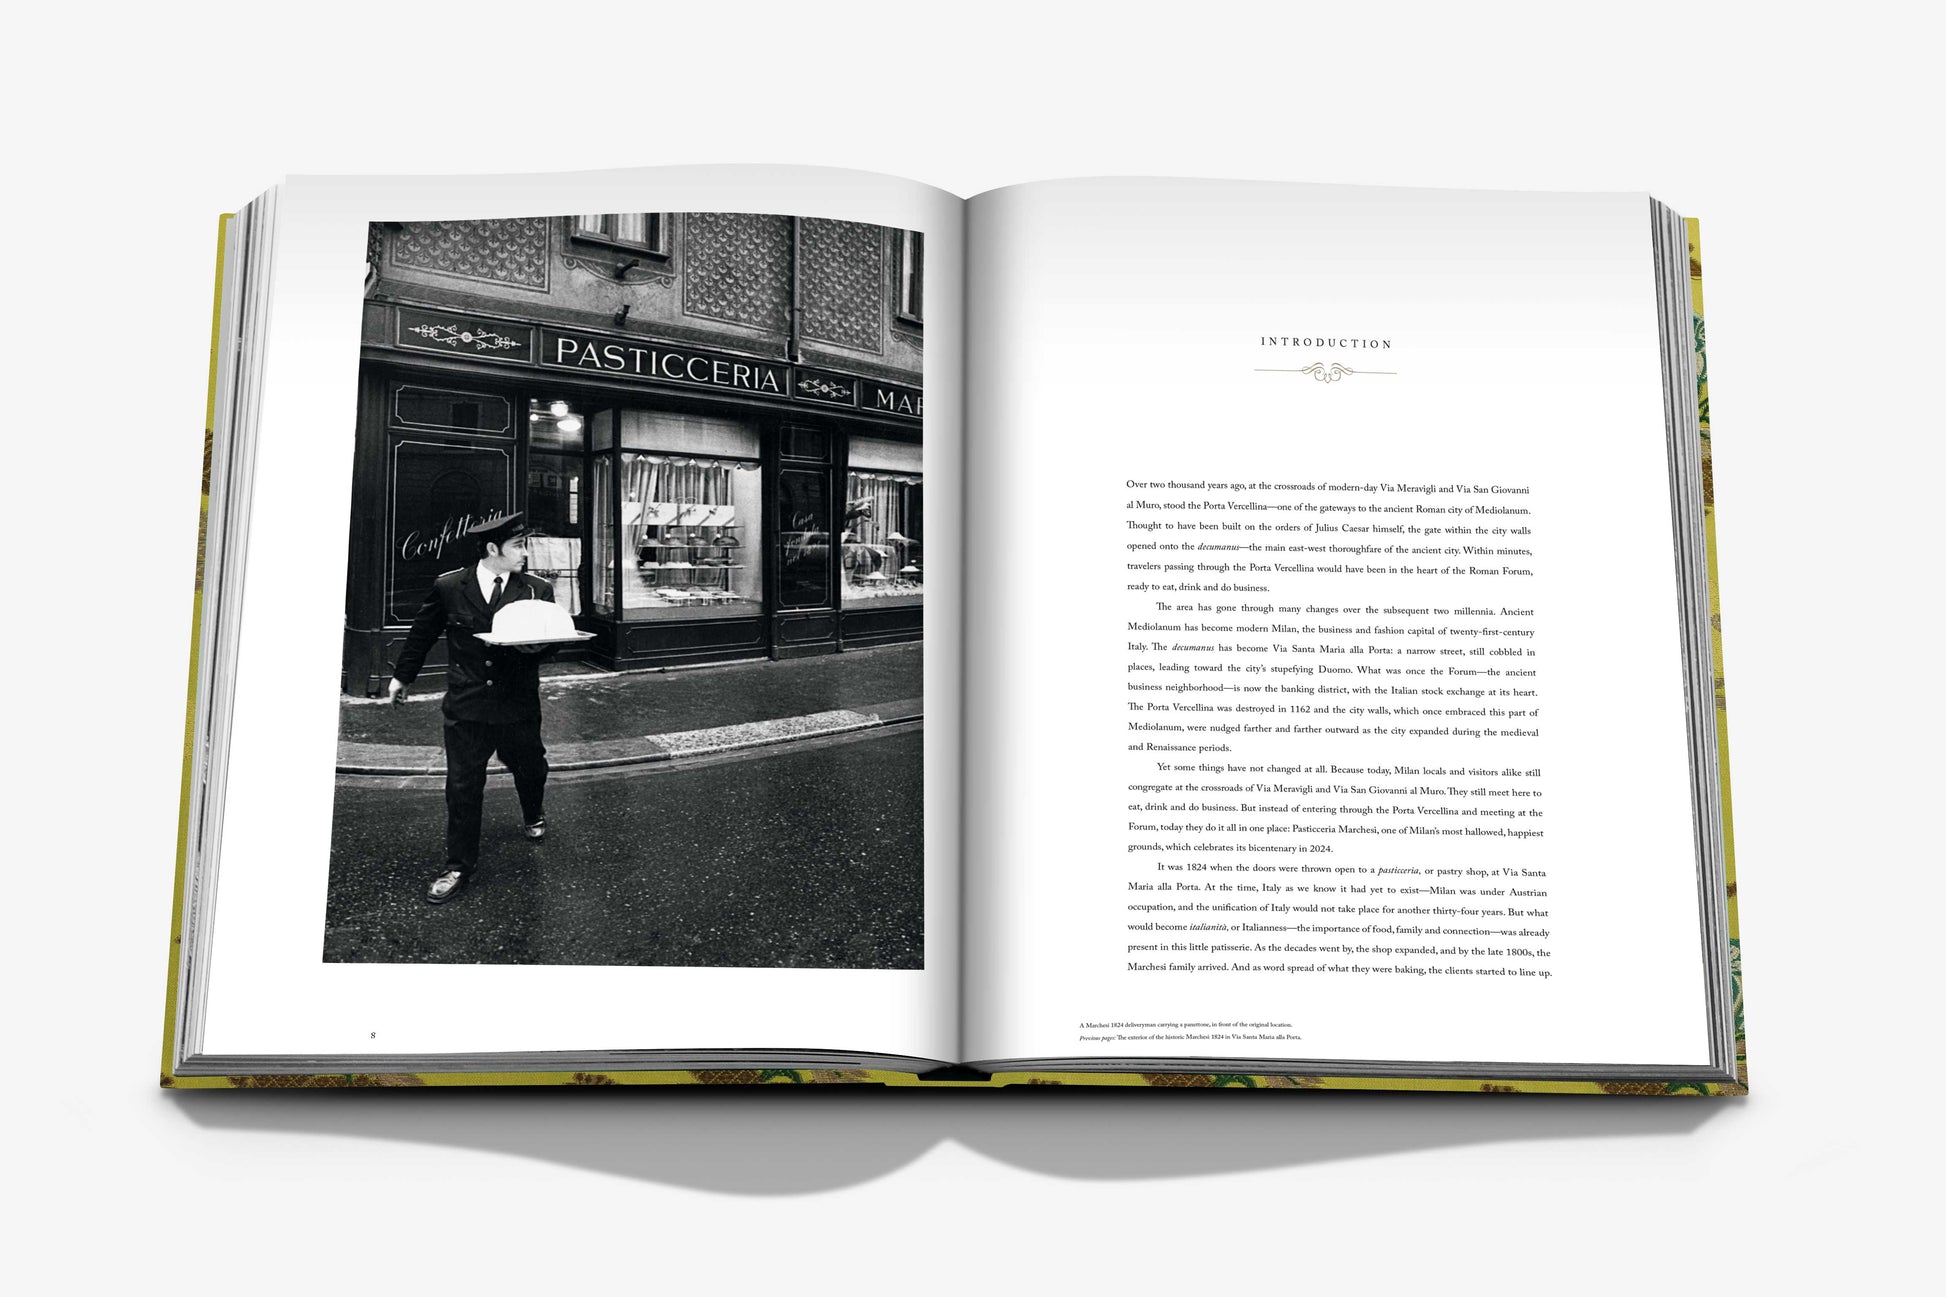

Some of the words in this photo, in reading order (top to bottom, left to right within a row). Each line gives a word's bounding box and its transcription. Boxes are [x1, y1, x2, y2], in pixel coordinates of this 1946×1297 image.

[1261, 336, 1391, 349] INTRODUCTION
[557, 338, 780, 392] PASTICCERIA
[1126, 479, 1148, 488] Over
[1167, 480, 1206, 489] thousand
[1207, 483, 1228, 491] years
[1230, 483, 1247, 492] ago,
[1258, 481, 1272, 490] the
[1274, 482, 1316, 490] crossroads
[1317, 482, 1327, 491] of
[1328, 483, 1378, 494] modern-day
[1380, 483, 1395, 492] Via
[1397, 483, 1436, 495] Meravigli
[1438, 484, 1454, 493] and
[1456, 484, 1471, 493] Via
[1473, 485, 1489, 494] San
[1490, 485, 1530, 494] Giovanni
[1126, 541, 1157, 552] opened
[1181, 542, 1195, 550] the
[1197, 542, 1262, 551] decumanus—the
[1265, 544, 1286, 552] main
[1288, 545, 1326, 553] east-west
[1329, 544, 1382, 555] thoroughfare
[1384, 545, 1394, 553] of
[1395, 545, 1409, 554] the
[1411, 546, 1442, 554] ancient
[1444, 546, 1461, 557] city.
[1462, 546, 1494, 555] Within
[1496, 547, 1533, 556] minutes,
[1127, 582, 1150, 593] ready
[1162, 584, 1177, 592] eat,
[1178, 582, 1201, 591] drink
[1203, 583, 1219, 591] and
[1220, 583, 1232, 591] do
[1233, 583, 1270, 592] business.
[1128, 622, 1181, 631] Mediolanum
[1184, 623, 1199, 631] has
[1201, 623, 1233, 632] become
[1236, 624, 1269, 632] modern
[1271, 624, 1300, 634] Milan,
[1302, 625, 1316, 633] the
[1318, 625, 1353, 634] business
[1355, 625, 1371, 634] and
[1374, 625, 1405, 635] fashion
[1407, 627, 1435, 637] capital
[1437, 627, 1448, 635] of
[1450, 627, 1535, 639] twenty-first-century
[1127, 662, 1155, 673] places,
[1159, 662, 1190, 674] leading
[1194, 663, 1223, 672] toward
[1227, 664, 1241, 672] the
[1245, 664, 1266, 675] city’s
[1270, 664, 1314, 676] stupefying
[1318, 665, 1353, 674] Duomo.
[1356, 665, 1381, 674] What
[1430, 667, 1444, 675] the
[1448, 667, 1501, 676] Forum—the
[1505, 668, 1536, 677] ancient
[1128, 722, 1185, 732] Mediolanum,
[1210, 723, 1241, 734] nudged
[1243, 723, 1272, 733] farther
[1275, 724, 1291, 733] and
[1293, 724, 1322, 733] farther
[1325, 725, 1360, 734] outward
[1374, 726, 1388, 735] the
[1390, 727, 1406, 737] city
[1409, 727, 1449, 737] expanded
[1452, 727, 1481, 738] during
[1483, 727, 1498, 736] the
[1500, 728, 1539, 737] medieval
[1128, 742, 1144, 751] and
[1146, 742, 1197, 752] Renaissance
[1198, 743, 1232, 754] periods.
[1128, 822, 1159, 832] Forum,
[1160, 823, 1184, 833] today
[1185, 823, 1204, 834] they
[1205, 823, 1217, 831] do
[1218, 823, 1224, 832] it
[1226, 823, 1237, 832] all
[1239, 824, 1247, 832] in
[1266, 824, 1290, 835] place:
[1292, 824, 1336, 833] Pasticceria
[1338, 825, 1380, 835] Marchesi,
[1398, 826, 1409, 834] of
[1409, 826, 1440, 835] Milan’s
[1465, 827, 1506, 837] hallowed,
[1507, 828, 1544, 839] happiest
[1127, 842, 1164, 853] grounds,
[1165, 842, 1191, 851] which
[1193, 843, 1234, 852] celebrates
[1236, 844, 1247, 852] its
[1248, 843, 1297, 855] bicentenary
[1309, 844, 1334, 853] 2024.
[1127, 922, 1153, 931] would
[1155, 922, 1188, 931] become
[1189, 923, 1229, 932] italianità,
[1242, 923, 1311, 932] Italianness—the
[1312, 924, 1360, 935] importance
[1361, 924, 1372, 933] of
[1372, 925, 1395, 934] food,
[1396, 925, 1423, 937] family
[1424, 926, 1441, 934] and
[1442, 927, 1517, 936] connection—was
[1518, 928, 1550, 939] already
[370, 1031, 376, 1039] 8
